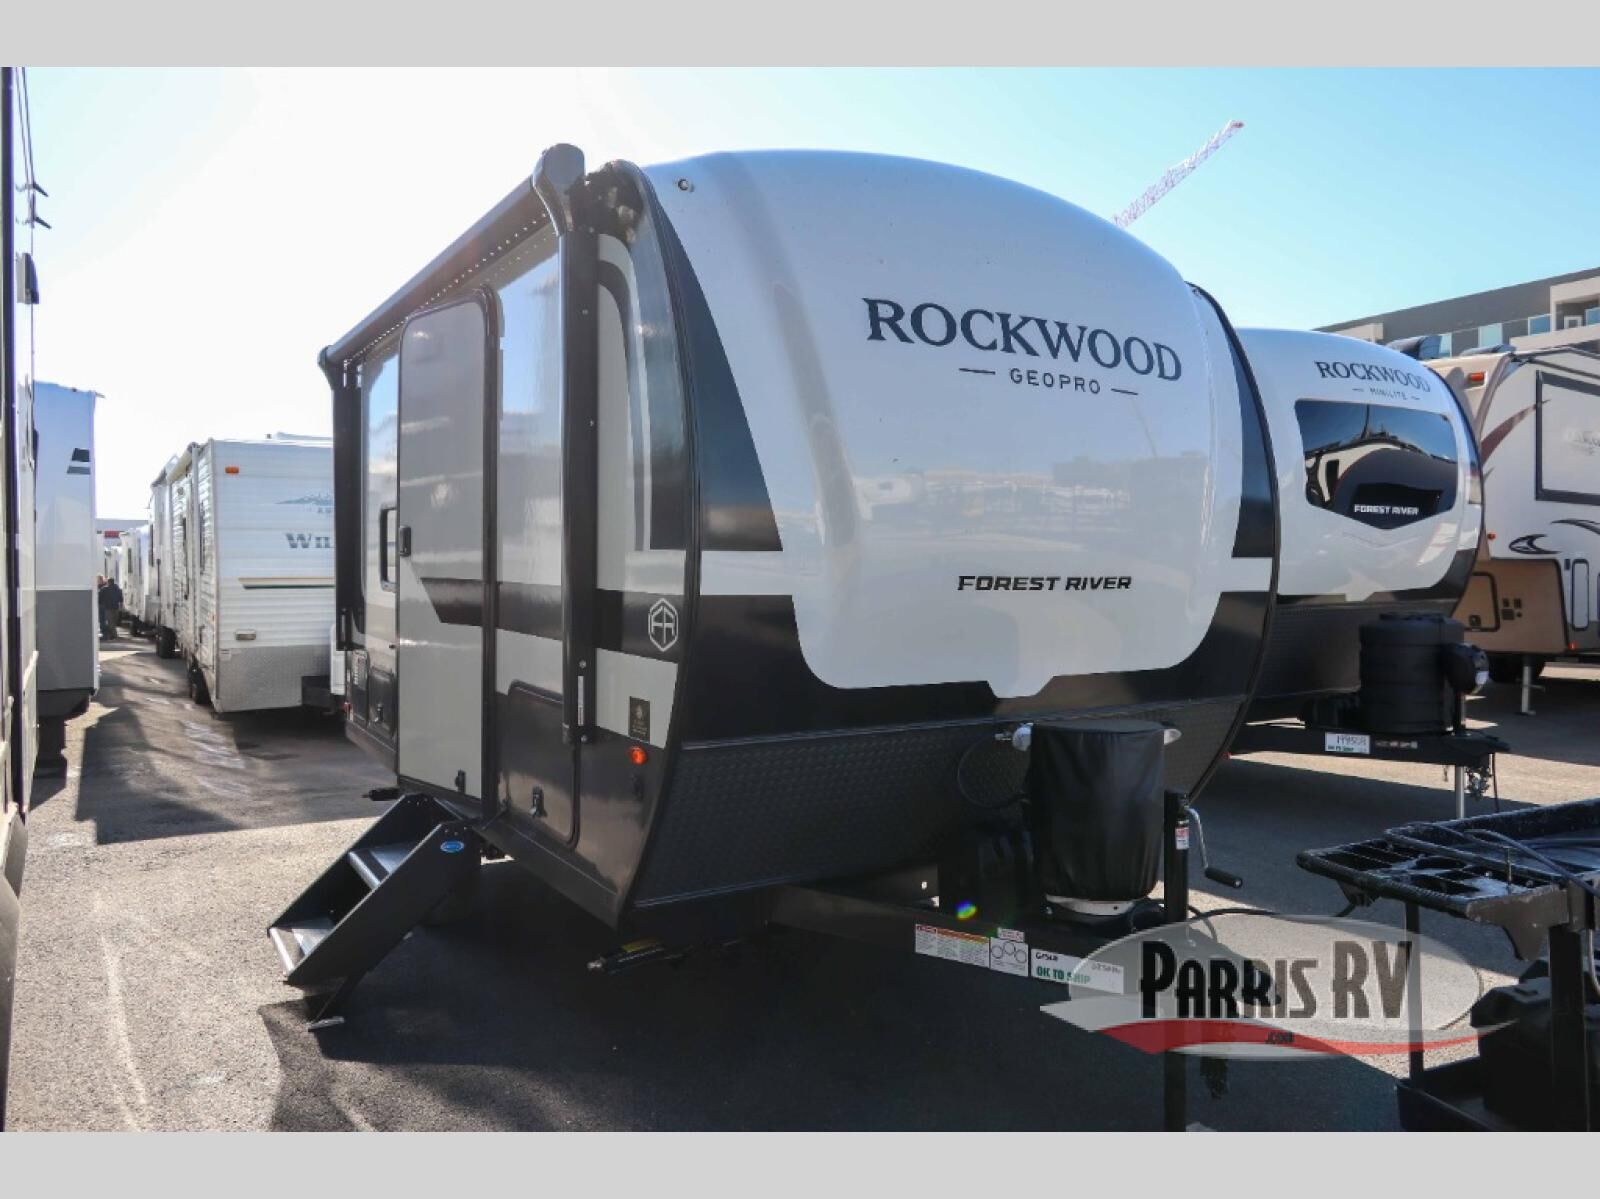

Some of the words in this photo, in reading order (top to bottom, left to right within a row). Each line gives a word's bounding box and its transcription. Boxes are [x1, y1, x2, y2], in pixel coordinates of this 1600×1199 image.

[862, 297, 1182, 382] ROCKWOOD
[1009, 367, 1101, 395] GEOPRO
[1315, 361, 1430, 393] ROCKWOOD
[1353, 504, 1391, 515] FOREST
[1391, 506, 1419, 516] RIVER
[956, 575, 1061, 591] FOREST
[1064, 576, 1133, 590] RIVER
[1036, 965, 1051, 978] OK
[1052, 968, 1066, 981] TO
